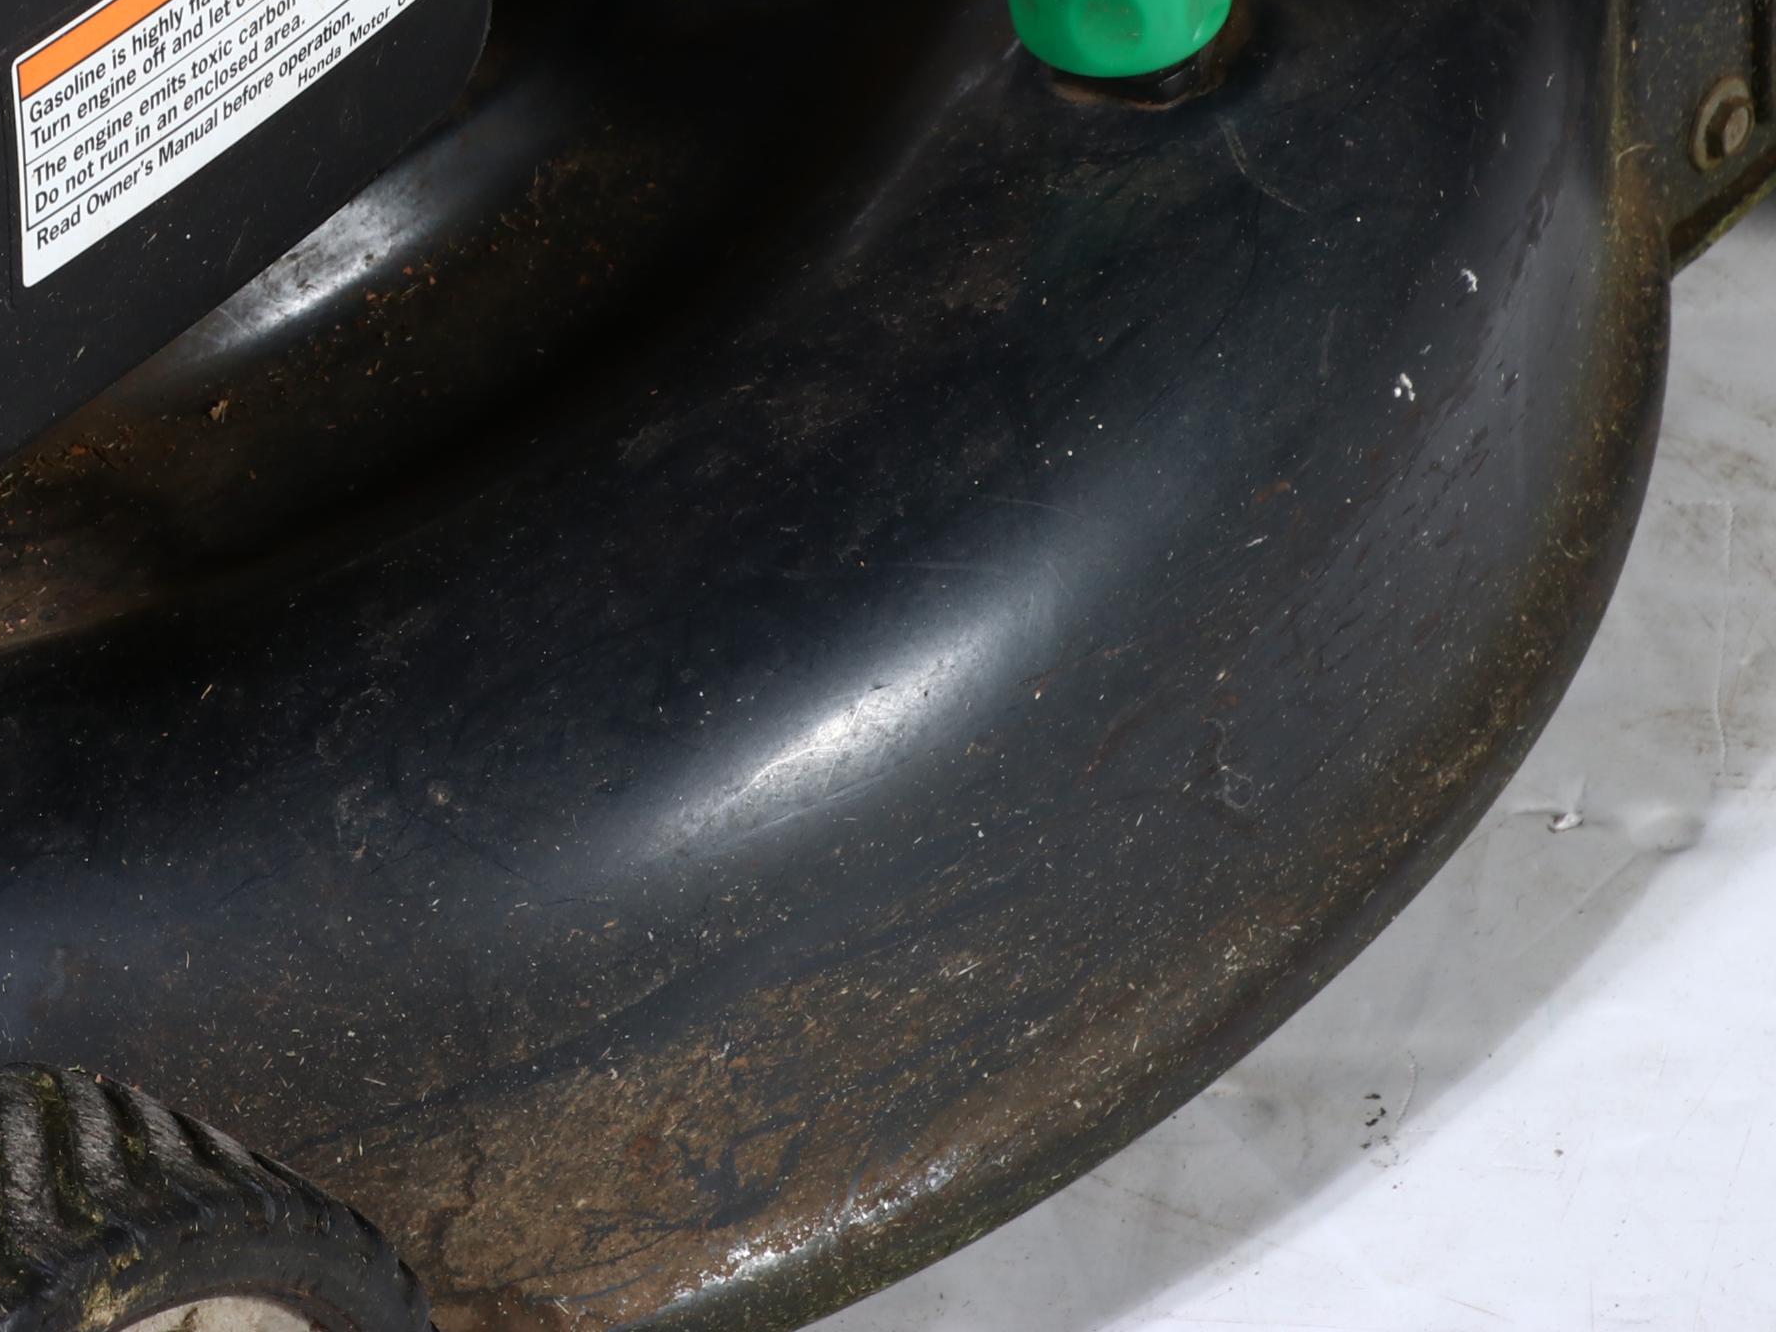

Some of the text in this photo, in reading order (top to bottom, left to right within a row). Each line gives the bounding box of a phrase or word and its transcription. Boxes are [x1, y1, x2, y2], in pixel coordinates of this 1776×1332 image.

[29, 63, 106, 123] Gasoline
[111, 49, 126, 69] is
[132, 6, 184, 56] highly
[30, 113, 71, 149] Turn
[77, 68, 137, 119] engine
[143, 42, 167, 74] off
[173, 16, 203, 54] and
[209, 0, 231, 29] let
[33, 155, 67, 186] The
[74, 110, 133, 162] engine
[139, 72, 186, 116] emits
[192, 39, 232, 79] toxic
[35, 14, 305, 213] Do not run in an enclosed area.
[298, 45, 341, 88] Honda
[349, 5, 391, 48] Motor
[36, 11, 355, 250] Read Owner's Manual before operation.
